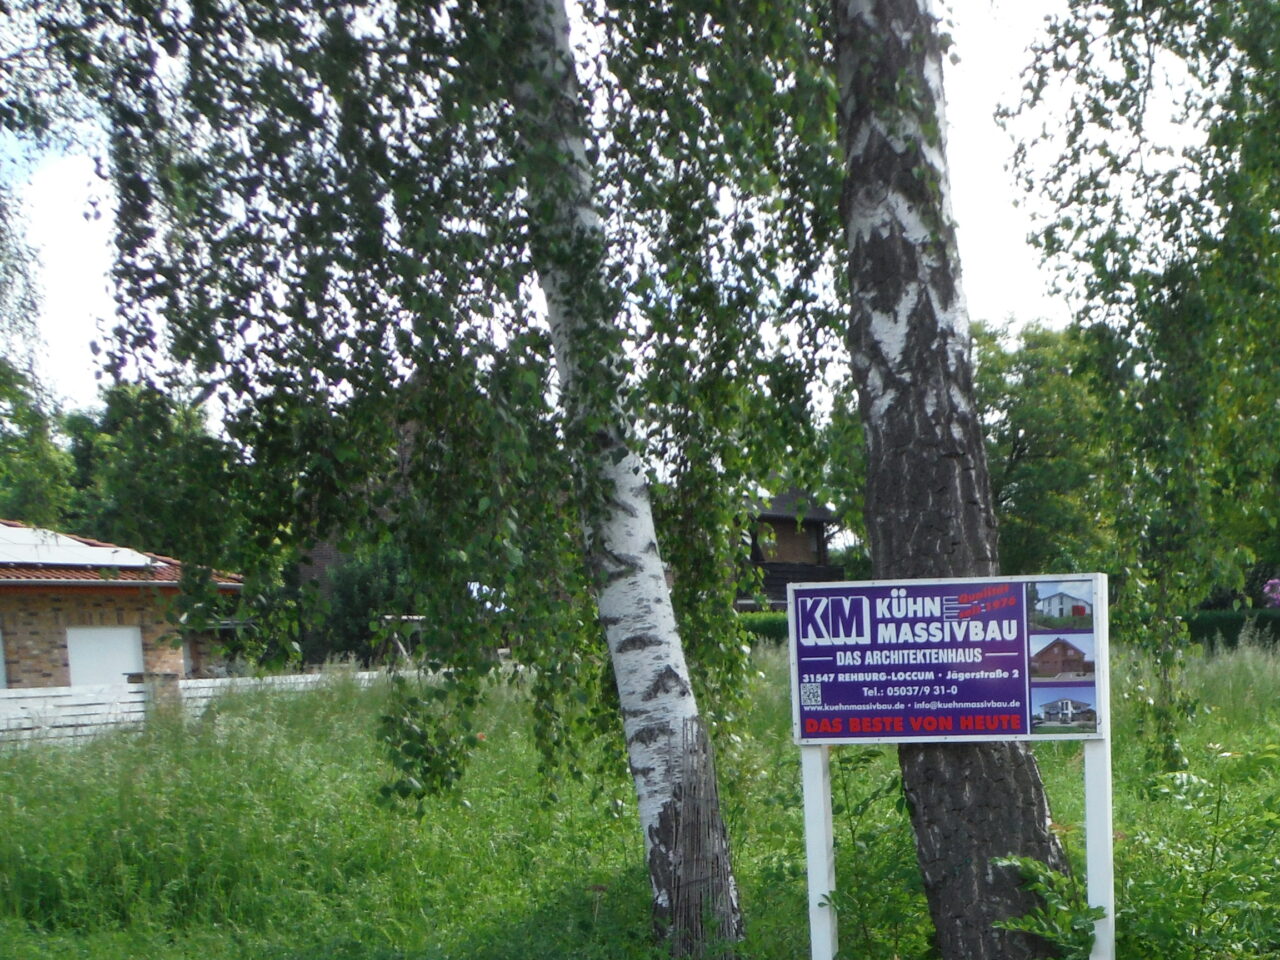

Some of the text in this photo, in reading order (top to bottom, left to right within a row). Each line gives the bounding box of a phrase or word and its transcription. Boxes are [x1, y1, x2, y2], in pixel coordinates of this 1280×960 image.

[876, 588, 941, 618] KÜHN
[798, 596, 871, 646] KM
[877, 620, 1017, 644] MASSIVBAU
[836, 648, 982, 666] DAS ARCHITEKTENHAUS
[802, 669, 1019, 683] 31547 REHBURG-LOCCUM Jägerstraße 2
[862, 685, 958, 696] Tel.: 05037/9 31-0
[804, 699, 1020, 711] www.kuehnmassivbau.de info@kuehnmassivbau.de
[805, 714, 1021, 733] DAS BESTE VON HEUTE
